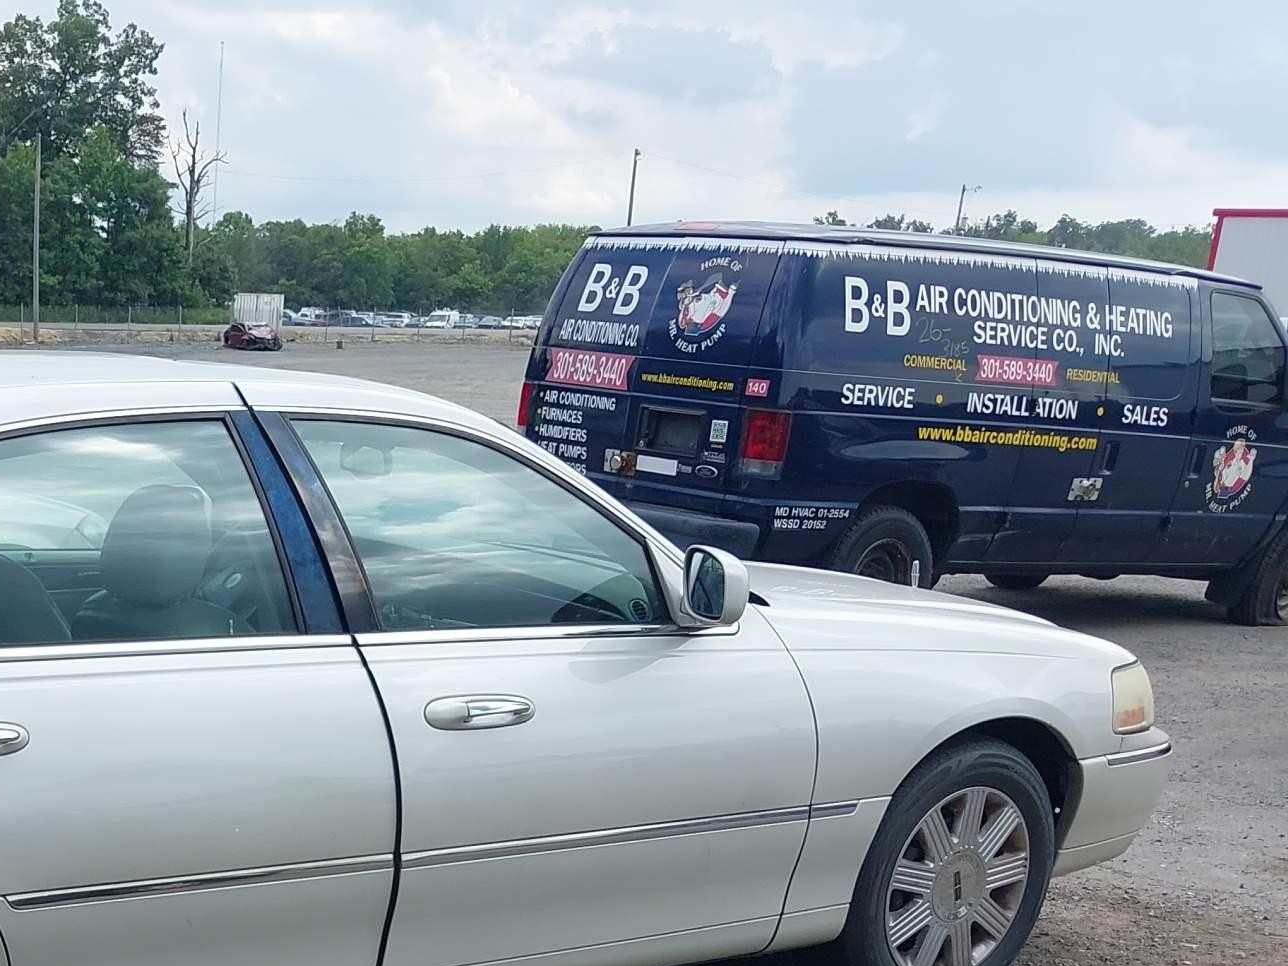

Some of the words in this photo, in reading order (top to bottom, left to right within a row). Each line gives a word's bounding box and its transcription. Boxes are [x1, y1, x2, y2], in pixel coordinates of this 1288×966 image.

[700, 256, 732, 271] HOME
[730, 260, 743, 272] OF
[578, 263, 649, 316] B&B
[845, 276, 911, 336] B&B
[916, 284, 948, 314] AIR
[954, 288, 1080, 327] CONDITIONING
[1086, 302, 1100, 330] &
[1105, 304, 1173, 338] HEATING
[559, 319, 574, 340] AIR
[572, 319, 626, 345] CONDITIONING
[625, 324, 640, 347] CO.
[668, 319, 677, 340] MR.
[675, 338, 698, 353] HEAT
[701, 323, 726, 351] PUMP
[973, 320, 1048, 349] SERVICE
[1053, 328, 1084, 356] CO.,
[1094, 333, 1125, 357] INC.
[553, 352, 626, 386] 301-589-3440
[903, 353, 967, 371] COMMERCIAL
[980, 358, 1053, 383] 301-589-3440
[641, 373, 734, 391] www.bbairconditioning.com
[1066, 368, 1120, 384] RESIDENTIAL
[748, 382, 767, 393] 140
[543, 390, 559, 402] AIR
[559, 391, 616, 411] CONDITIONING
[840, 383, 916, 409] SERVICE
[1122, 404, 1169, 426] SALES
[541, 406, 583, 424] FURNACES
[538, 424, 587, 442] HUMIDIFIERS
[918, 425, 1098, 452] www.bbairconditioning.com
[1226, 425, 1248, 439] HOME
[1247, 429, 1258, 441] OF
[558, 443, 587, 460] PUMPS
[1208, 501, 1228, 513] HEAT
[1230, 484, 1252, 510] PUMP
[775, 507, 789, 516] MD
[791, 508, 816, 518] HVAC
[817, 509, 849, 519] 01-2554
[773, 519, 800, 529] WSSD
[802, 520, 827, 529] 20152
